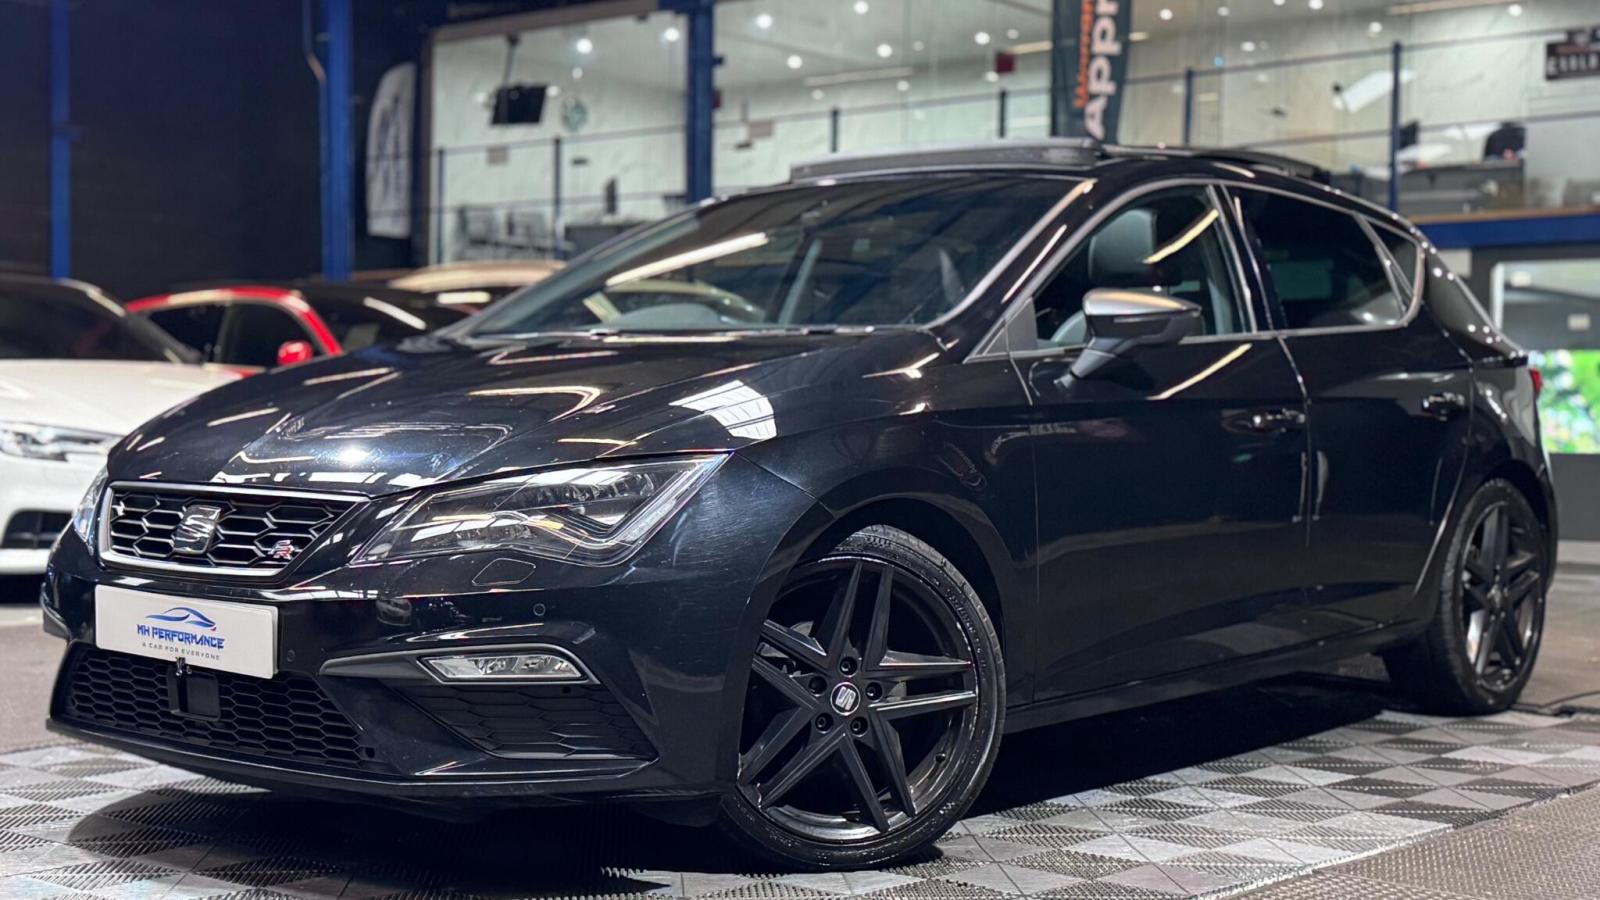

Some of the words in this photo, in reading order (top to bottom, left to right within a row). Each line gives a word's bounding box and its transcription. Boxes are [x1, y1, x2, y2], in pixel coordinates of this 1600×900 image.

[152, 627, 225, 649] PERFORMANCE
[165, 645, 179, 653] FOR
[181, 648, 220, 661] EVERYONE
